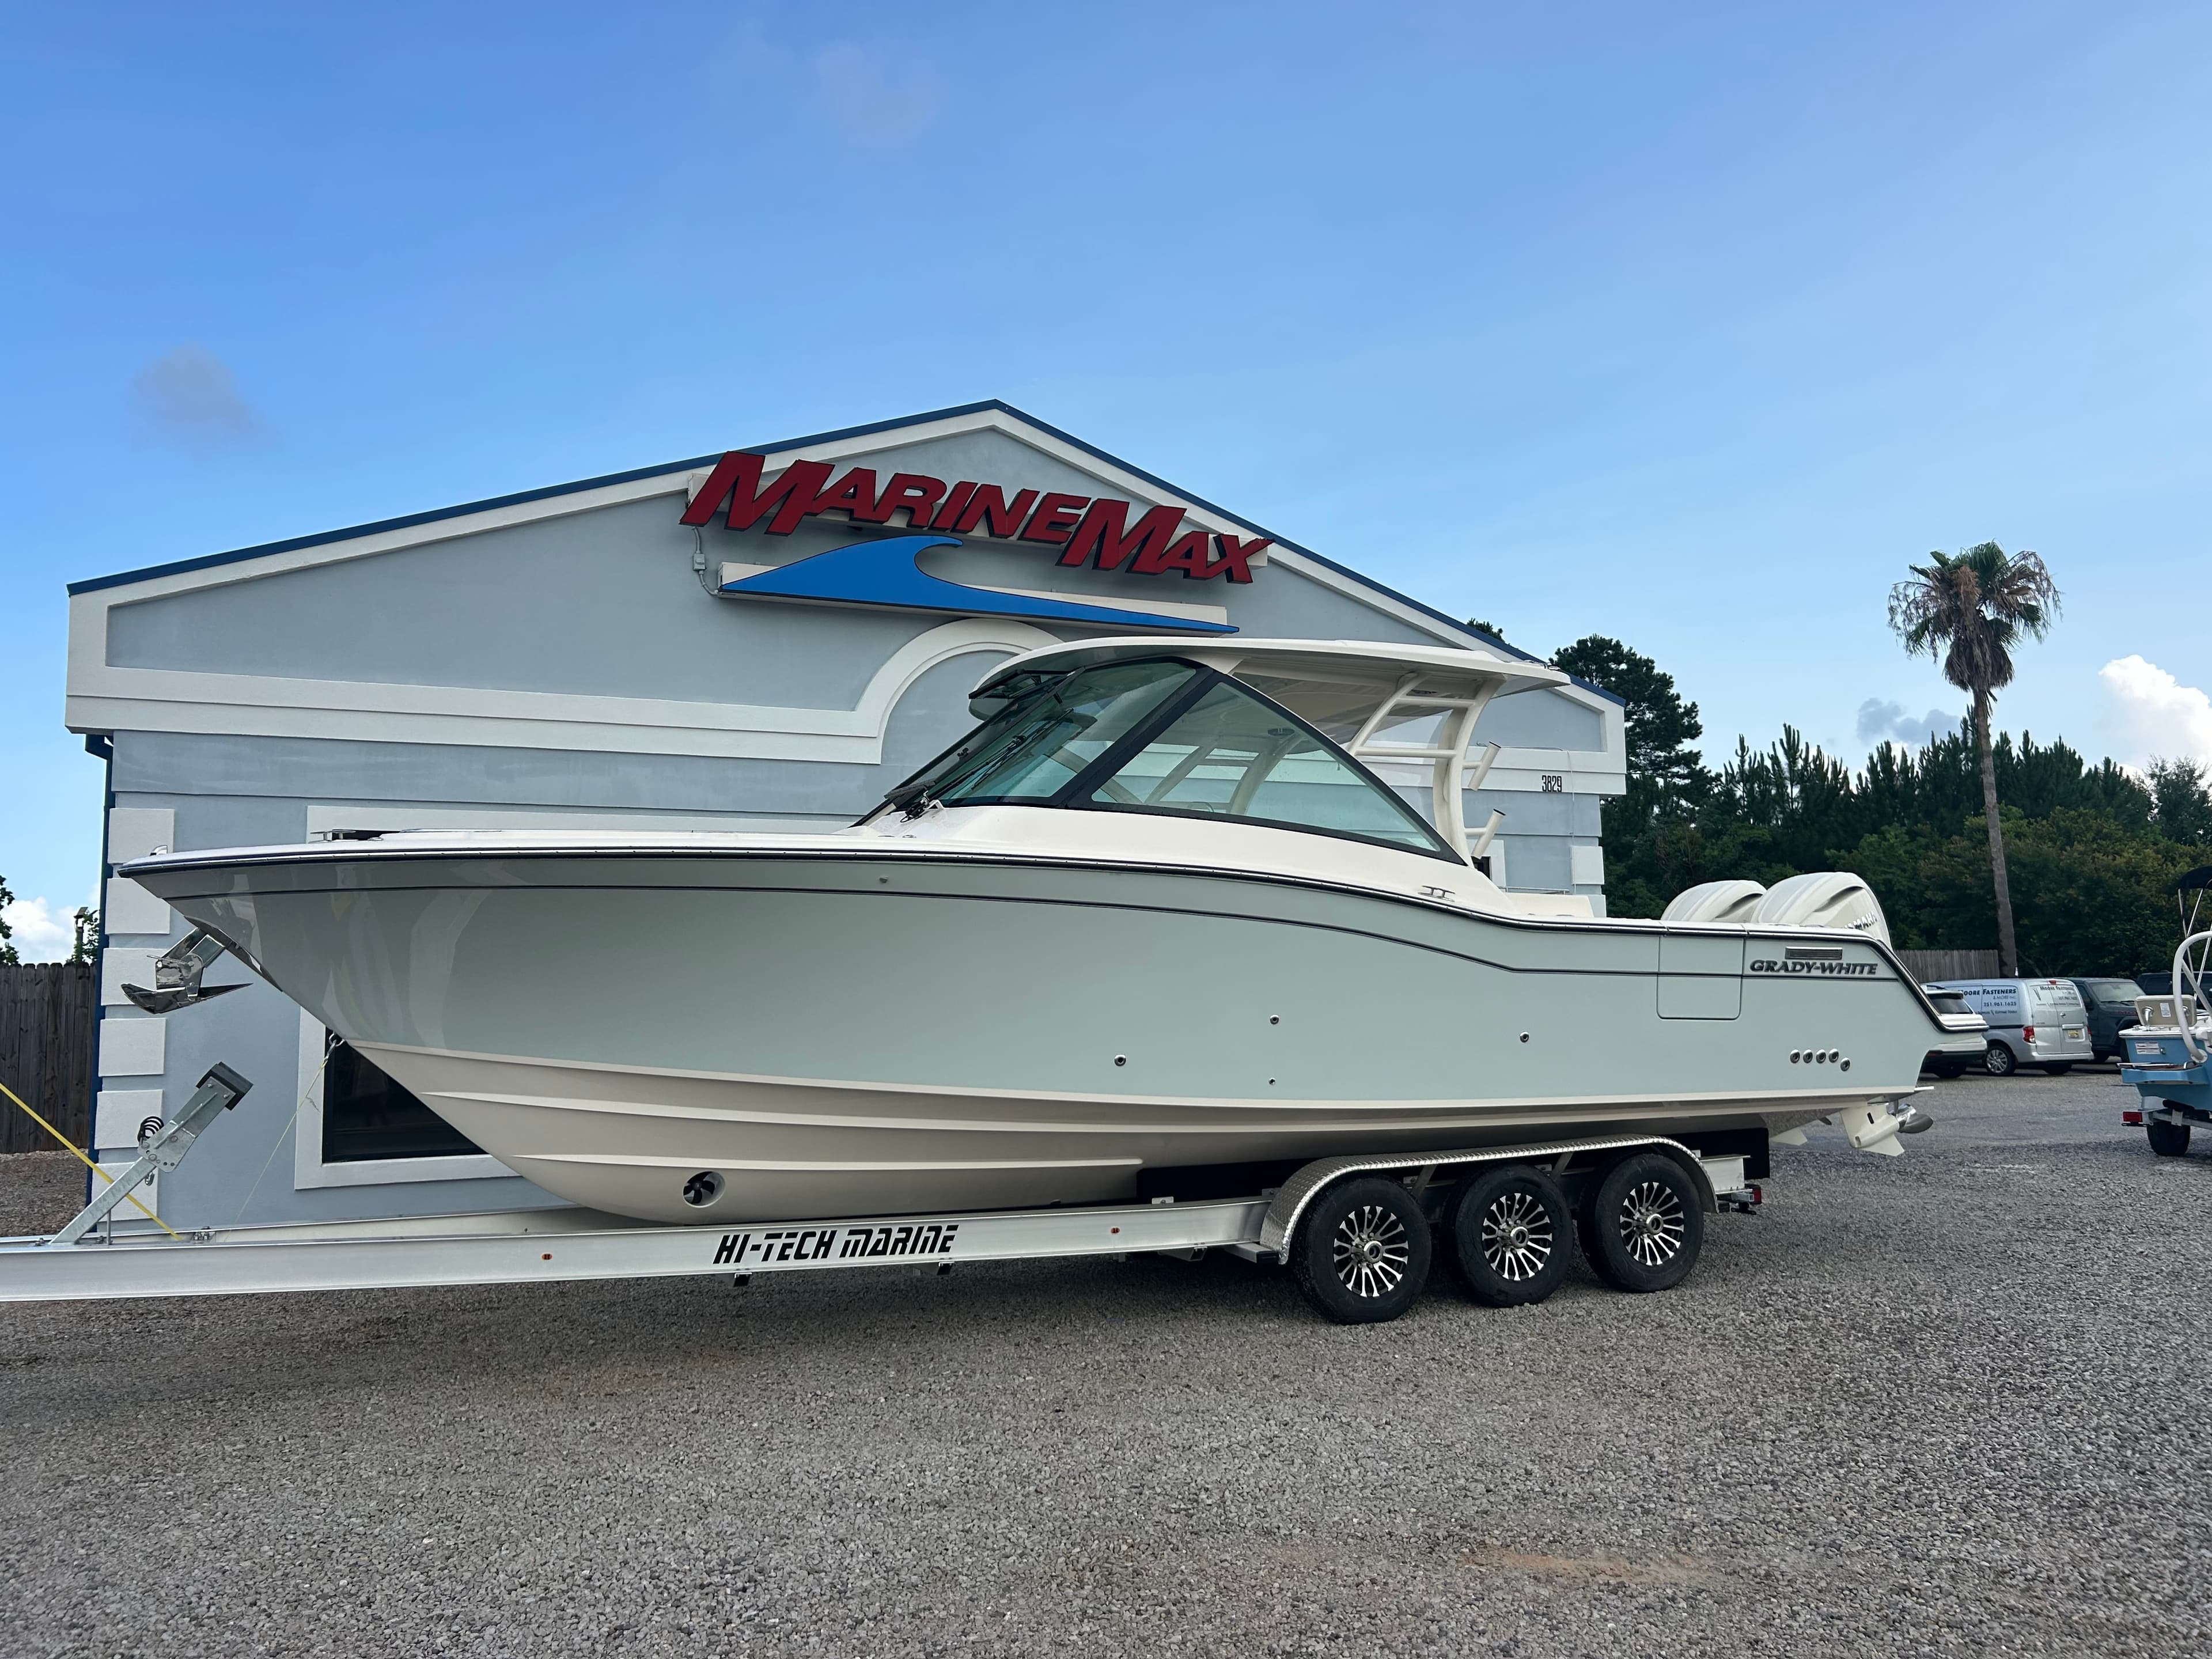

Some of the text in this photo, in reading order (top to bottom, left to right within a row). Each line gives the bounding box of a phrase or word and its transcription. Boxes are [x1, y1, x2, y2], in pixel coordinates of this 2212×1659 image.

[1541, 775, 1562, 793] 3829
[1750, 960, 1878, 975] GRADY-WHITE
[713, 1225, 959, 1264] HI-TECH MARINE
